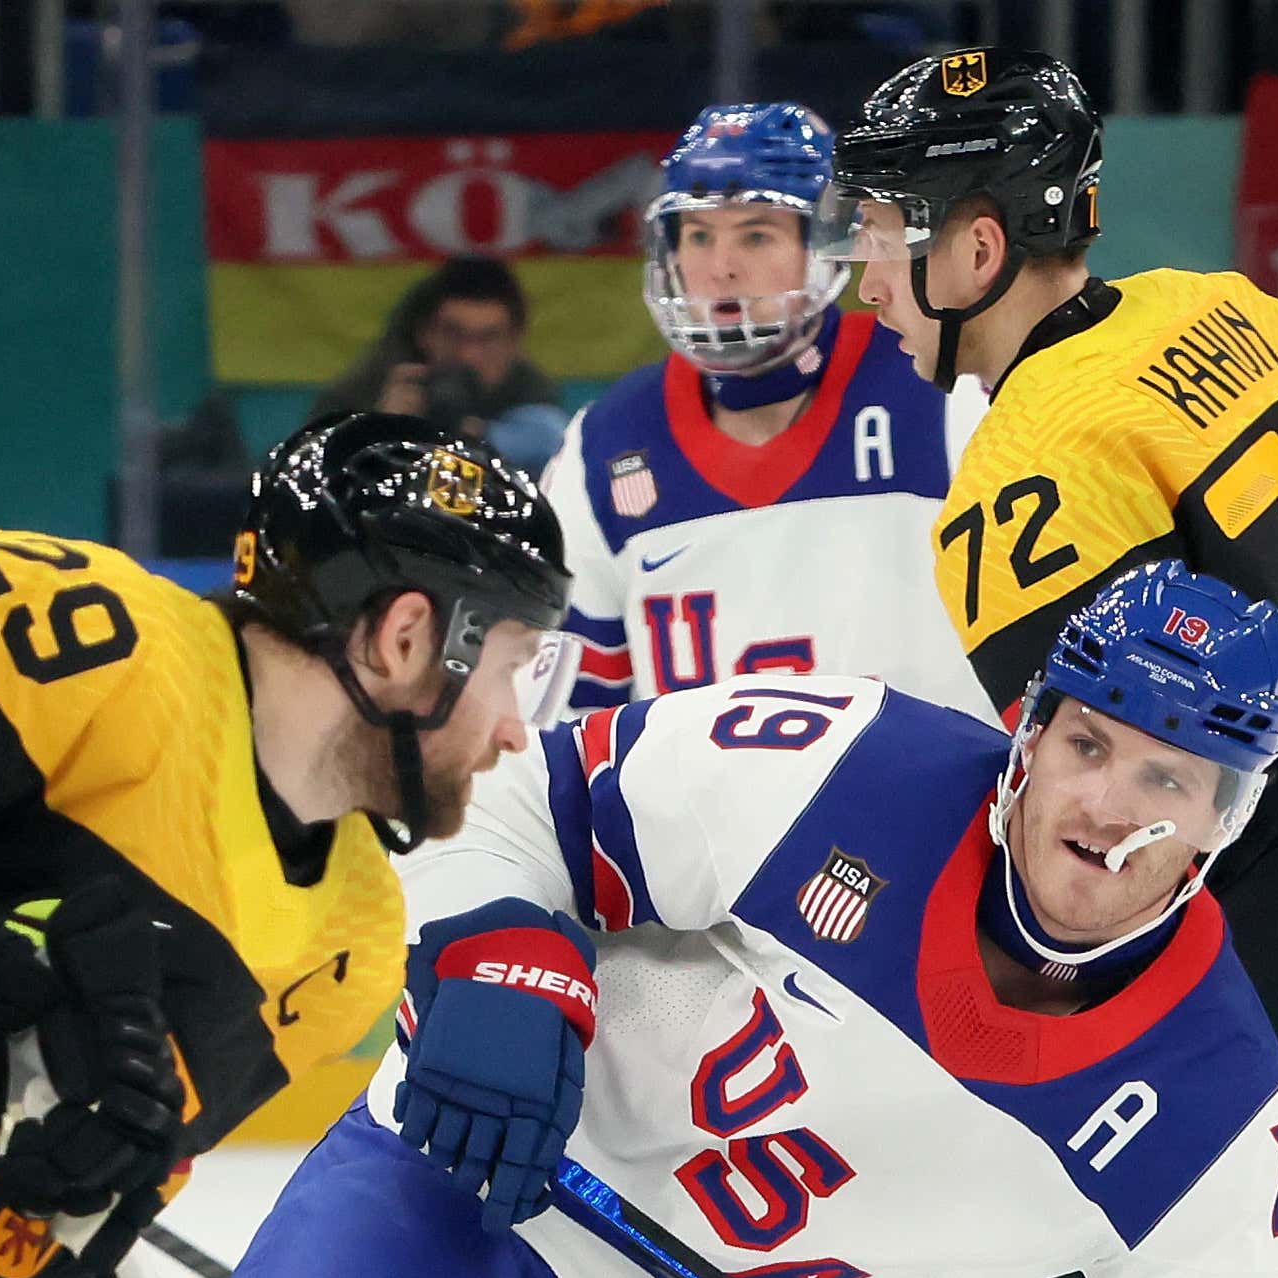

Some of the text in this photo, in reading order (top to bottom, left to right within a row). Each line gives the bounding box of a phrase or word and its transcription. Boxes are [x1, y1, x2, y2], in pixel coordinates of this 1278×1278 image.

[855, 406, 895, 481] A
[940, 474, 1079, 627] 72
[1163, 606, 1210, 646] 19
[1126, 654, 1195, 691] MILANO CORTINA
[709, 687, 856, 751] 19
[829, 857, 871, 894] USA
[472, 961, 597, 1016] SHER
[1067, 1080, 1158, 1173] A
